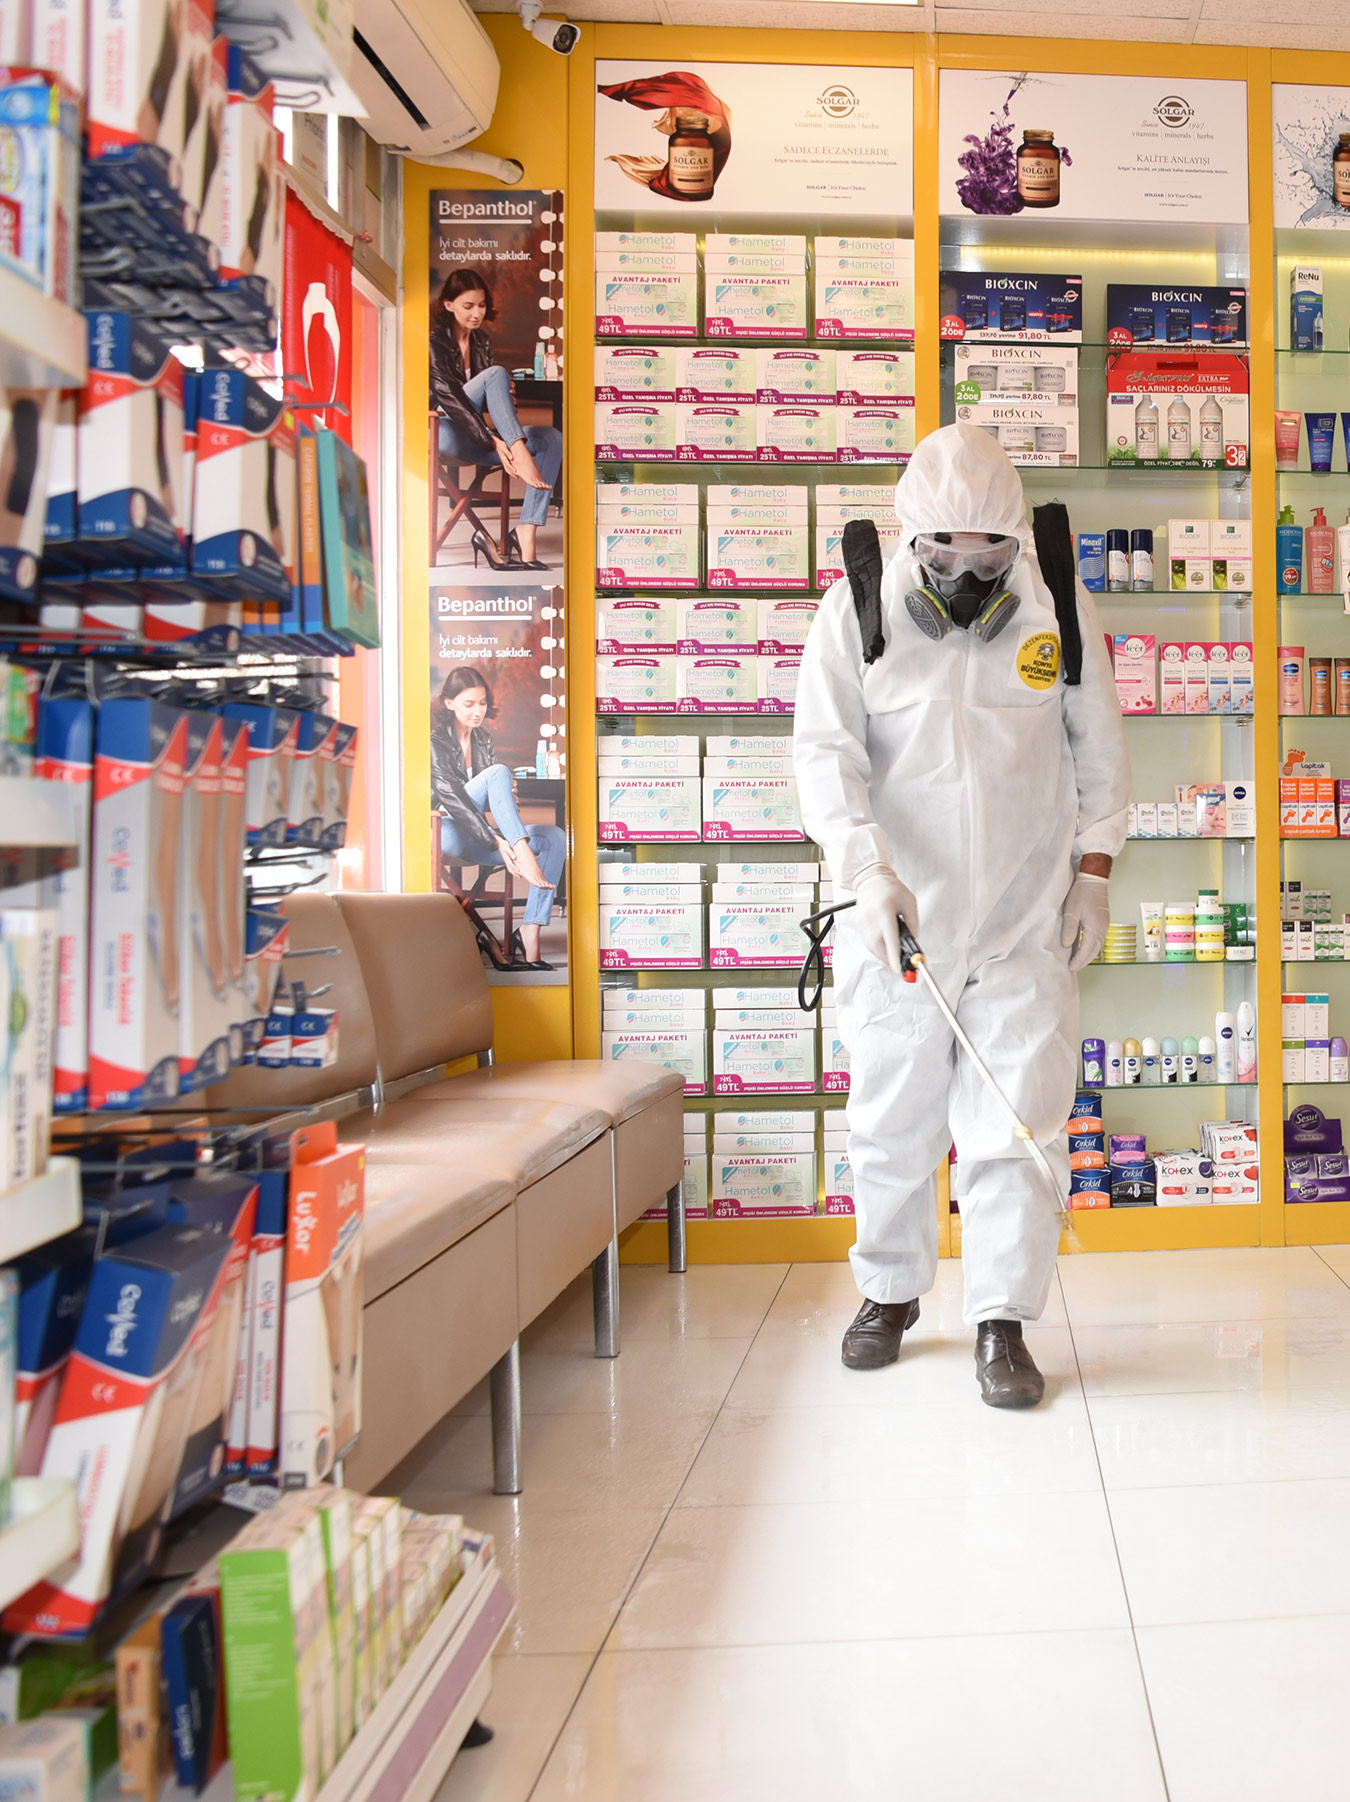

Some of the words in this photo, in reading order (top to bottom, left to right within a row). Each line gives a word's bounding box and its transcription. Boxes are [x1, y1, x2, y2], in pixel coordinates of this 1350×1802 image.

[816, 97, 860, 105] SOLGAR
[1152, 106, 1195, 117] SOLGAR
[1132, 130, 1158, 138] vitamins
[1164, 131, 1191, 139] minerals
[1197, 132, 1214, 140] herbs
[784, 145, 820, 154] SADECE
[822, 146, 889, 156] ECZANELERDE
[673, 156, 709, 166] SOLGAR
[1136, 153, 1169, 164] KALİTE
[1170, 155, 1210, 166] ANLAYIŞI
[1022, 166, 1055, 175] SOLGAR
[439, 200, 533, 220] Bepanthol
[439, 237, 452, 250] İyi
[454, 237, 467, 248] cilt
[469, 236, 499, 248] bakımı
[627, 235, 675, 245] Hametol
[439, 250, 492, 263] detaylarda
[495, 250, 532, 262] saklıdır.
[1298, 272, 1319, 282] ReNu
[985, 278, 1038, 290] BIOXCIN
[1152, 290, 1203, 302] BIOXCIN
[992, 348, 1041, 358] BIOXCIN
[1126, 385, 1175, 393] SAÇLARINIZ
[1177, 384, 1231, 392] DÖKÜLMESİN
[993, 408, 1042, 419] BIOXCIN
[438, 596, 533, 616] Bepanthol
[439, 634, 450, 647] İyi
[452, 634, 466, 645] cilt
[468, 635, 498, 645] bakımı
[439, 647, 492, 660] detaylarda
[495, 648, 532, 659] saklıdır.
[1219, 1134, 1243, 1142] kotex
[1162, 1165, 1194, 1175] kotex
